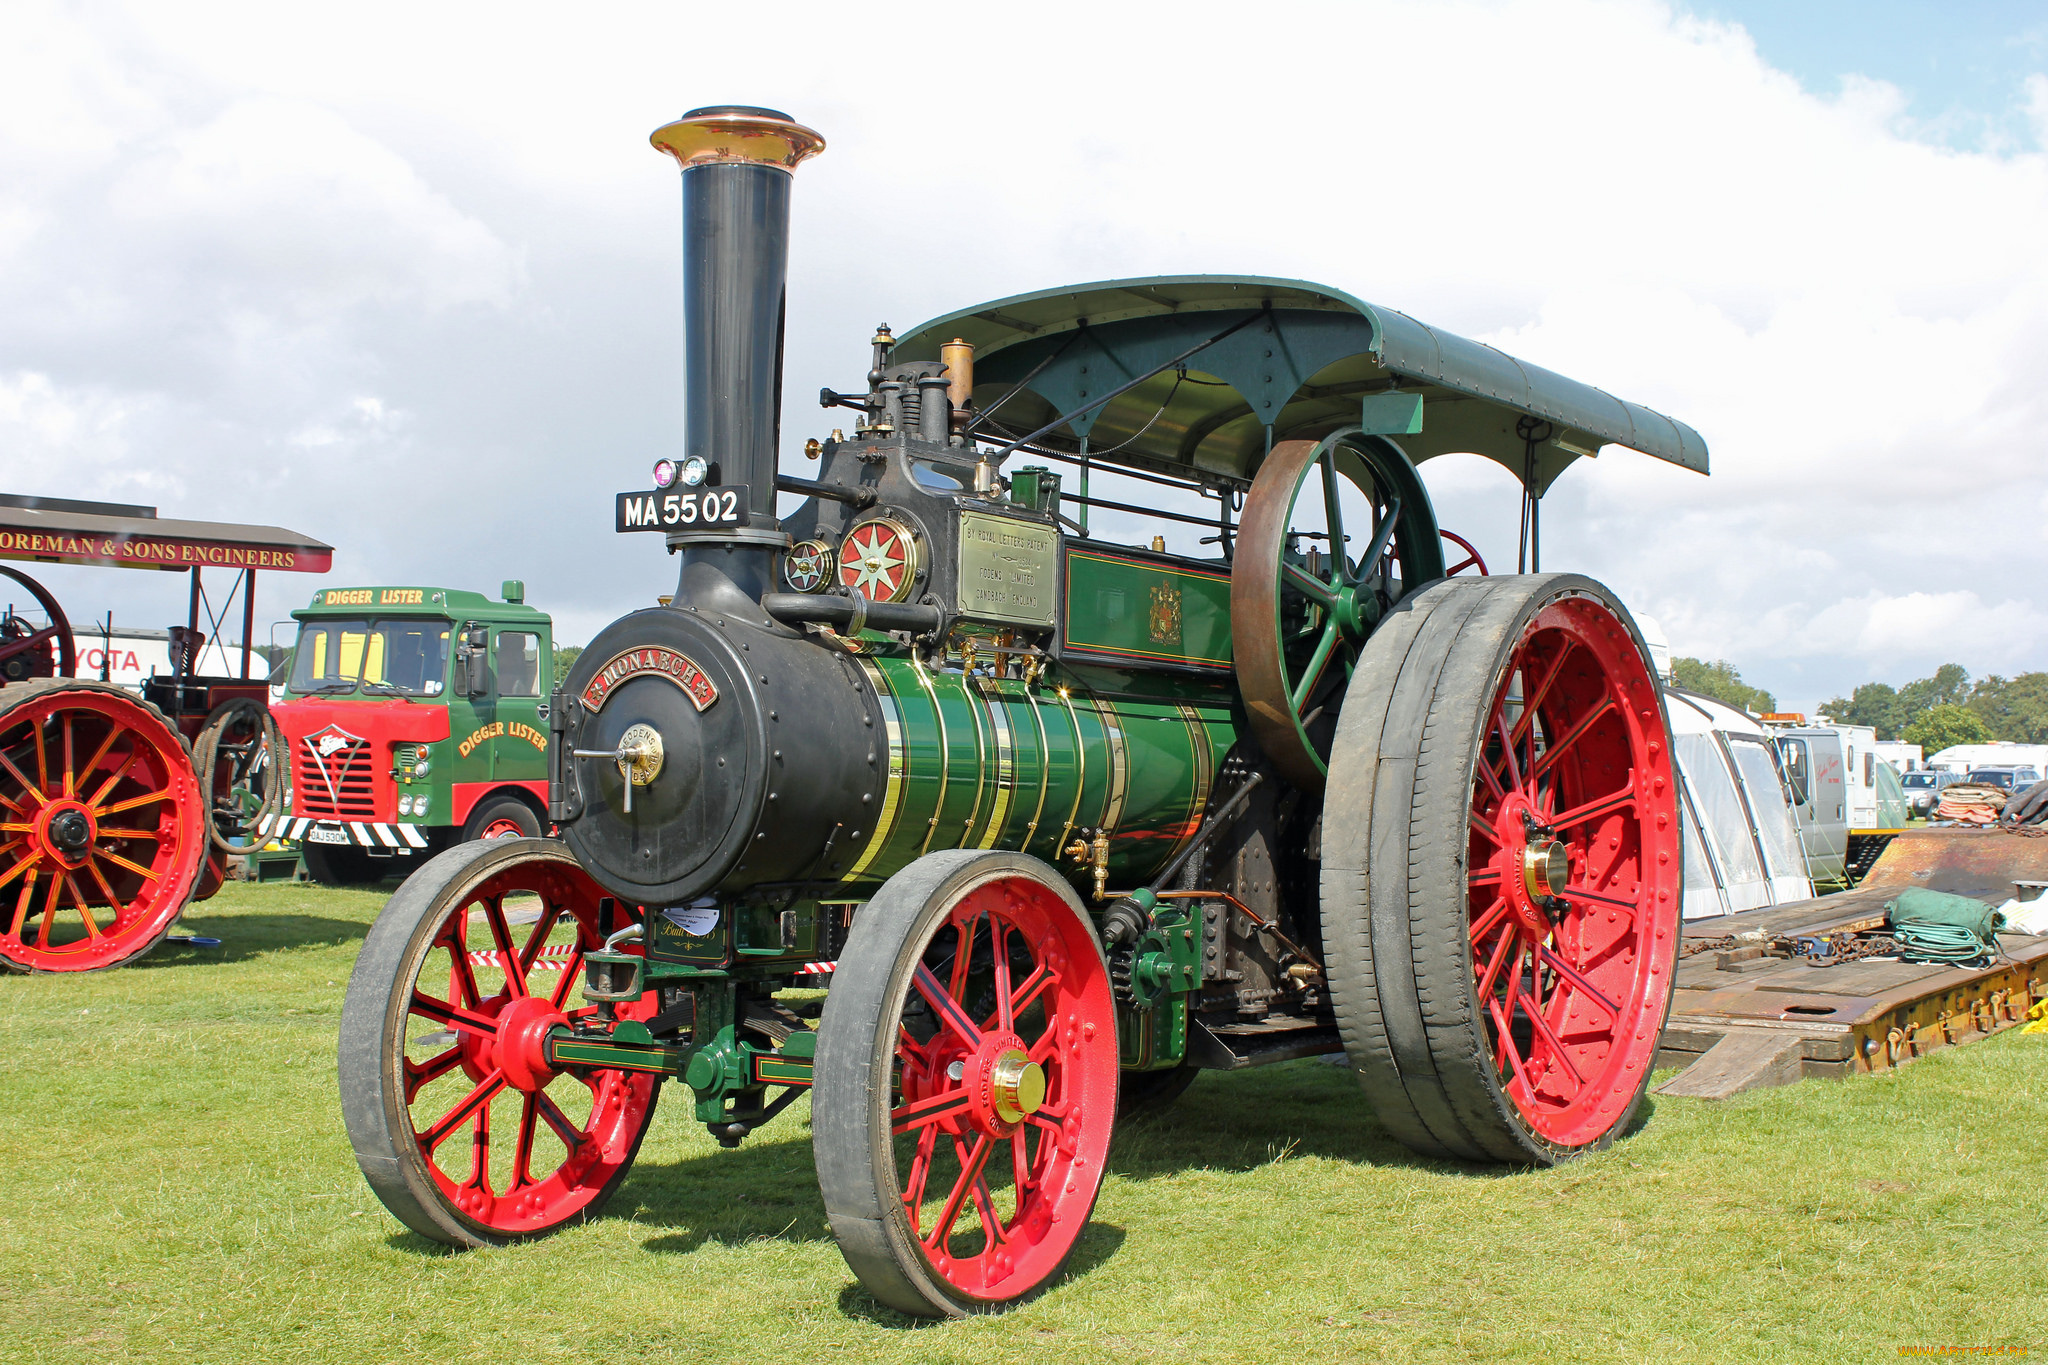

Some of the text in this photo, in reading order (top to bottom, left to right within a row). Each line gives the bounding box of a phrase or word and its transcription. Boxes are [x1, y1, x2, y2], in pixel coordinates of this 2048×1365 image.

[0, 532, 295, 567] OREMAN & SONS ENGINEERS
[967, 528, 1048, 552] BY ROYAL LETTERS PATENT
[980, 568, 1035, 586] FODENS LIMITED
[325, 589, 423, 606] DIGGER LISTER
[976, 589, 1037, 607] SANDBACH ENGLAND
[602, 650, 698, 688] MONARCH
[458, 722, 547, 758] DIGGER LISTER
[623, 728, 656, 746] FODENS
[981, 1058, 992, 1108] FODENS
